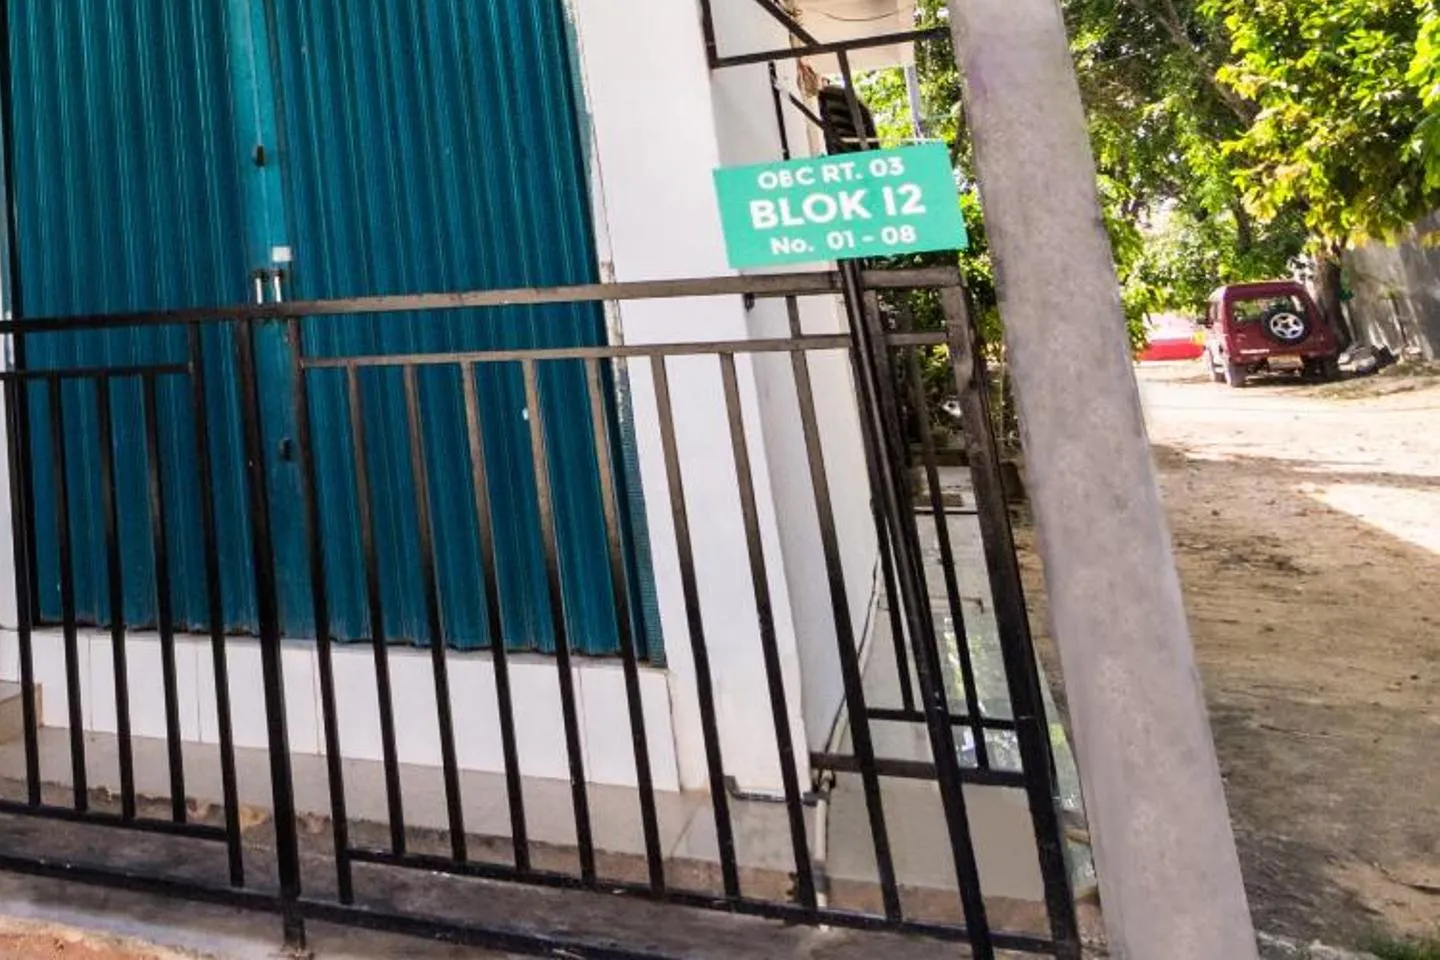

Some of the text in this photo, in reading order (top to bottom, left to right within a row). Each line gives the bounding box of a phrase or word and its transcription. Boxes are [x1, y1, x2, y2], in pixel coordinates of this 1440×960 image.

[758, 156, 905, 190] OBC RT. 03
[750, 189, 872, 230] BLOK
[770, 235, 815, 255] No.
[825, 229, 856, 251] 01
[881, 224, 917, 246] 08
